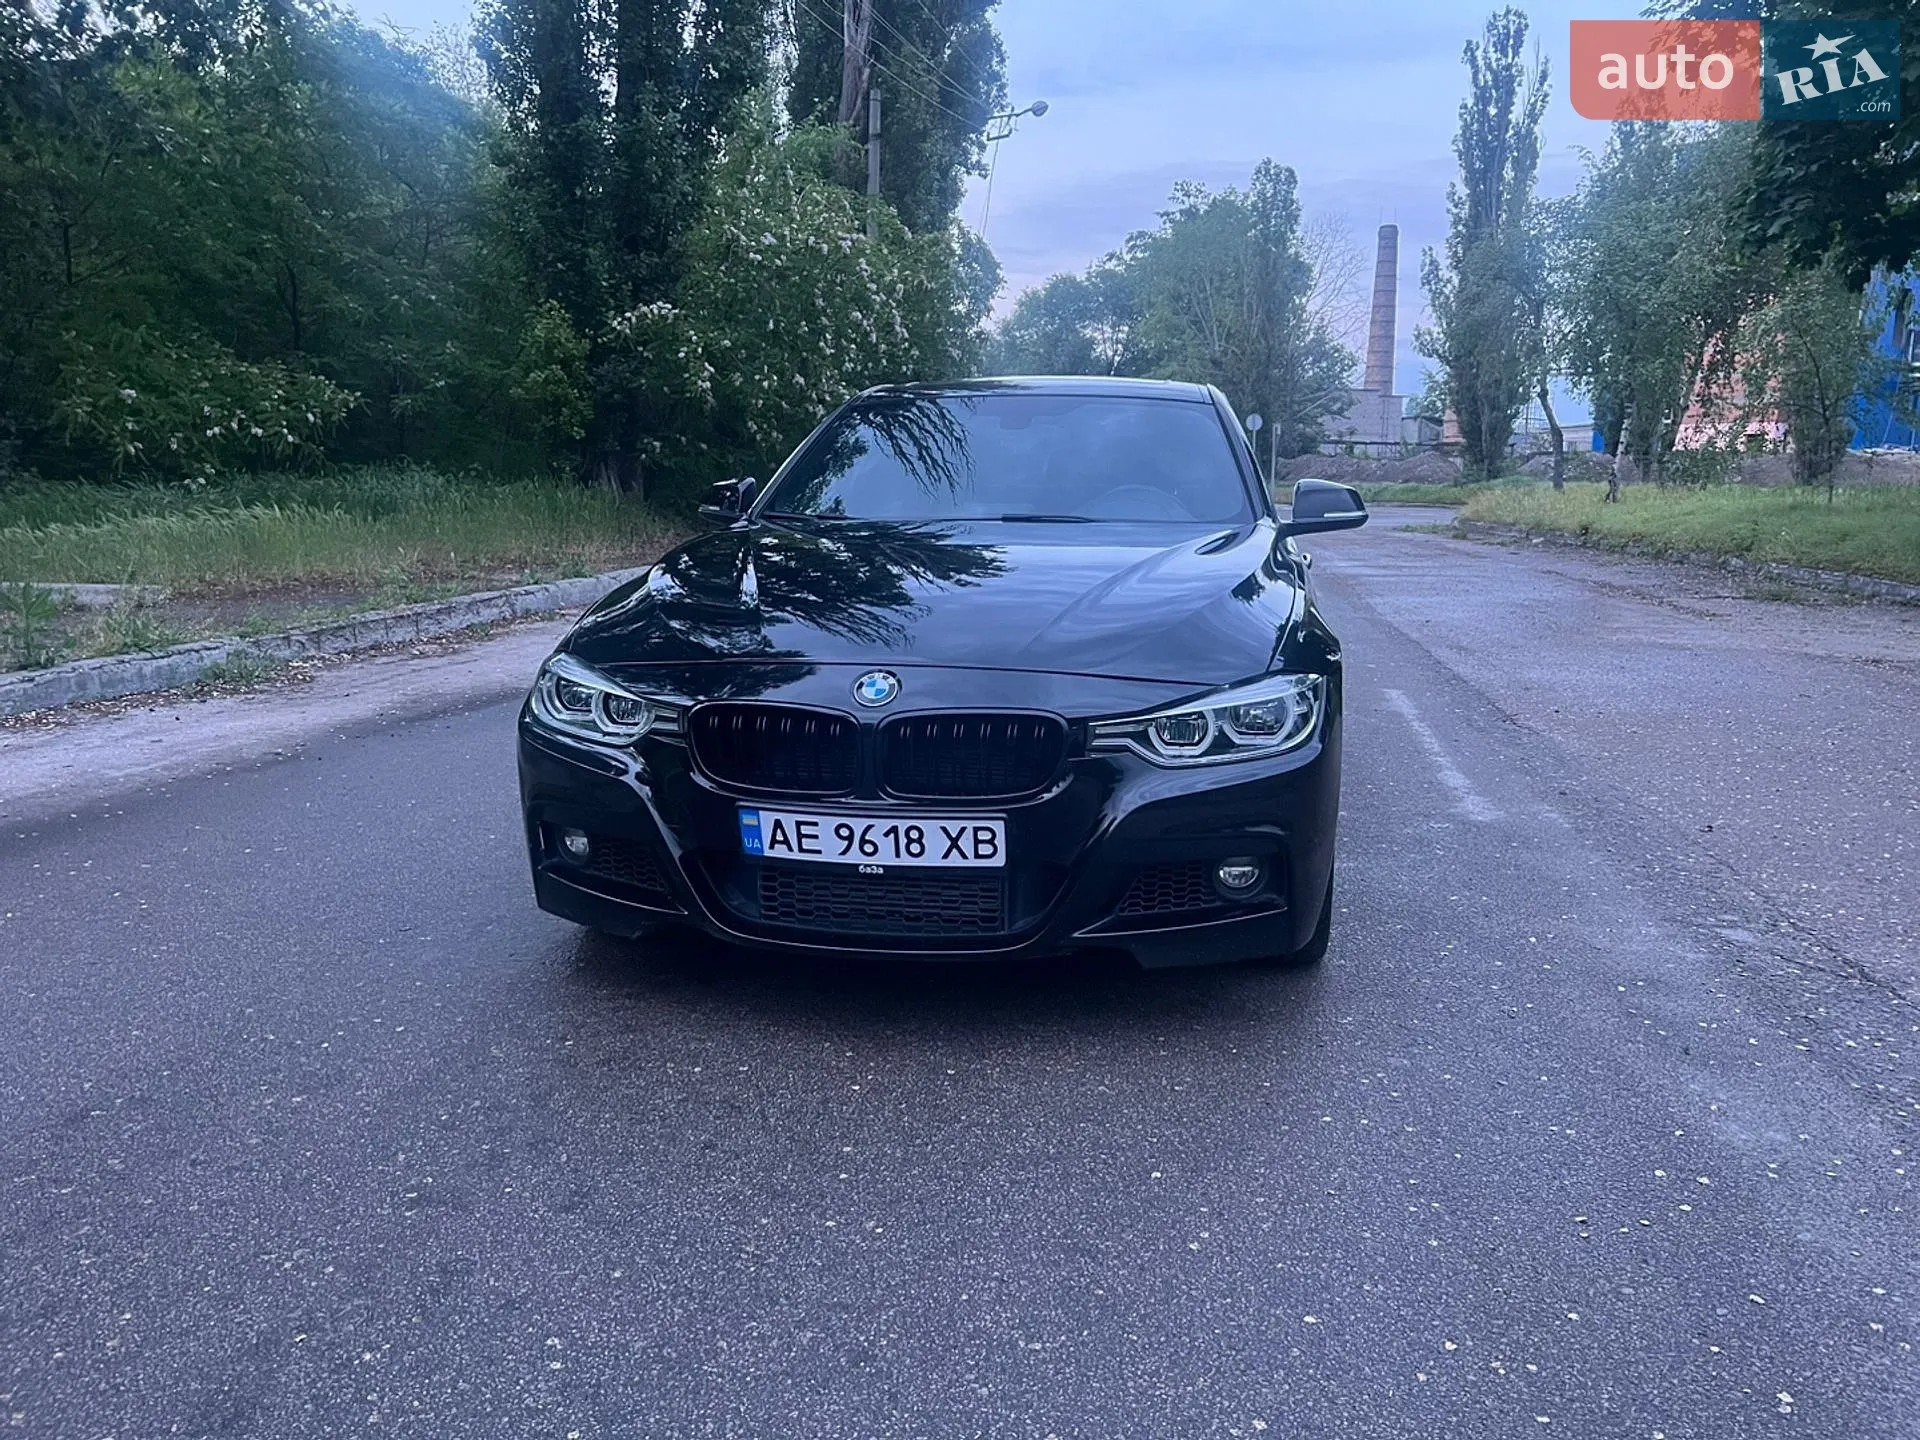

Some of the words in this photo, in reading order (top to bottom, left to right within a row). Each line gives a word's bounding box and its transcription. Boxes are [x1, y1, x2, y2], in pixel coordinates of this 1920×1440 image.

[745, 837, 761, 849] UA
[768, 818, 823, 855] AE
[833, 822, 926, 859] 9618
[939, 825, 999, 860] XB
